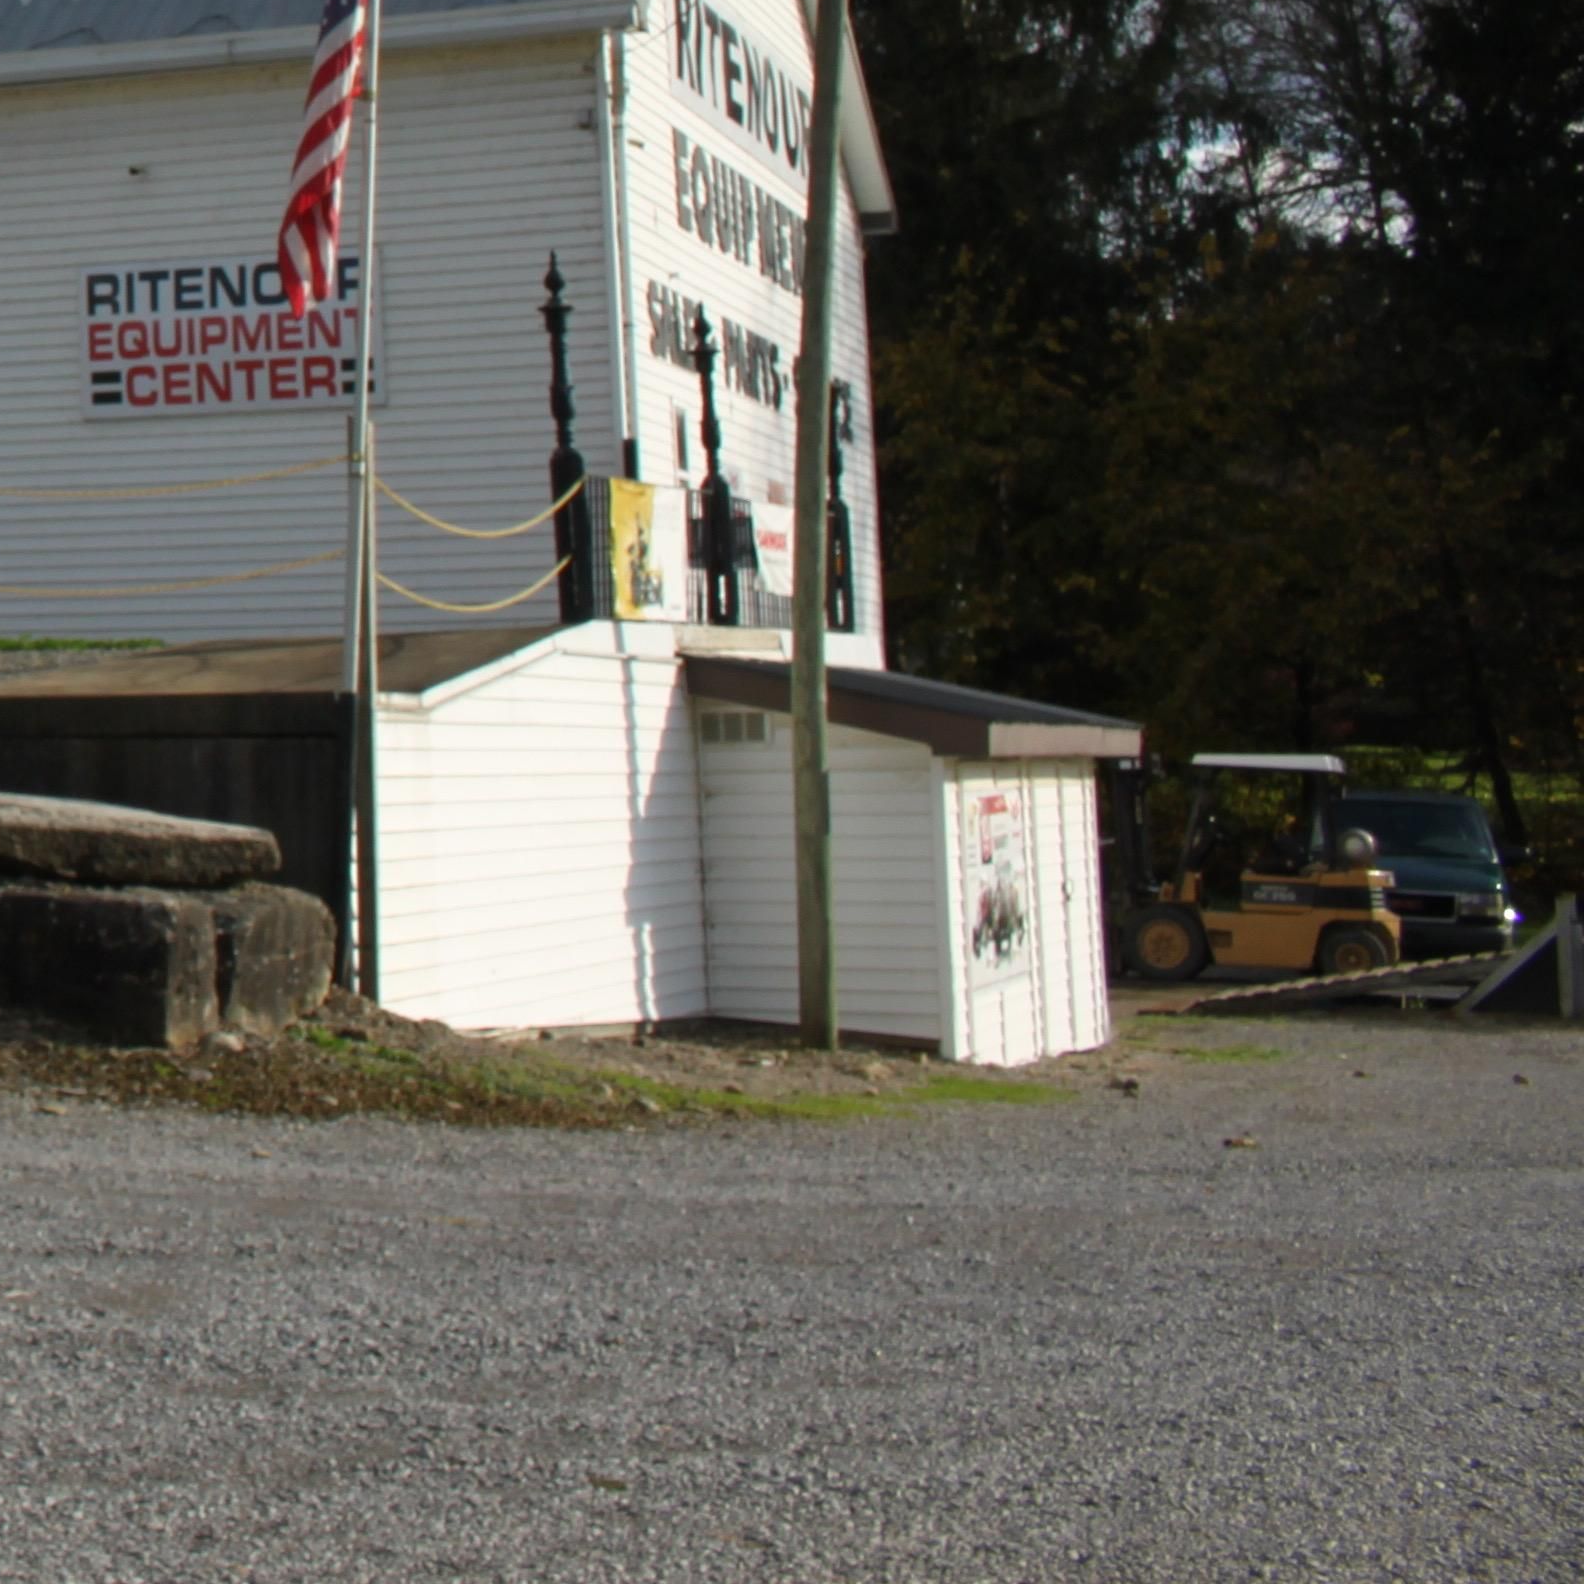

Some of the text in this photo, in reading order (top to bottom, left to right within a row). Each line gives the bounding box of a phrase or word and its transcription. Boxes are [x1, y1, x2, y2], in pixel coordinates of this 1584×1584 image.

[672, 125, 806, 296] EQUIPMEN
[86, 257, 360, 316] RITENOR
[125, 356, 337, 407] CENTER
[647, 279, 717, 376] SALE
[722, 316, 781, 412] PARTS
